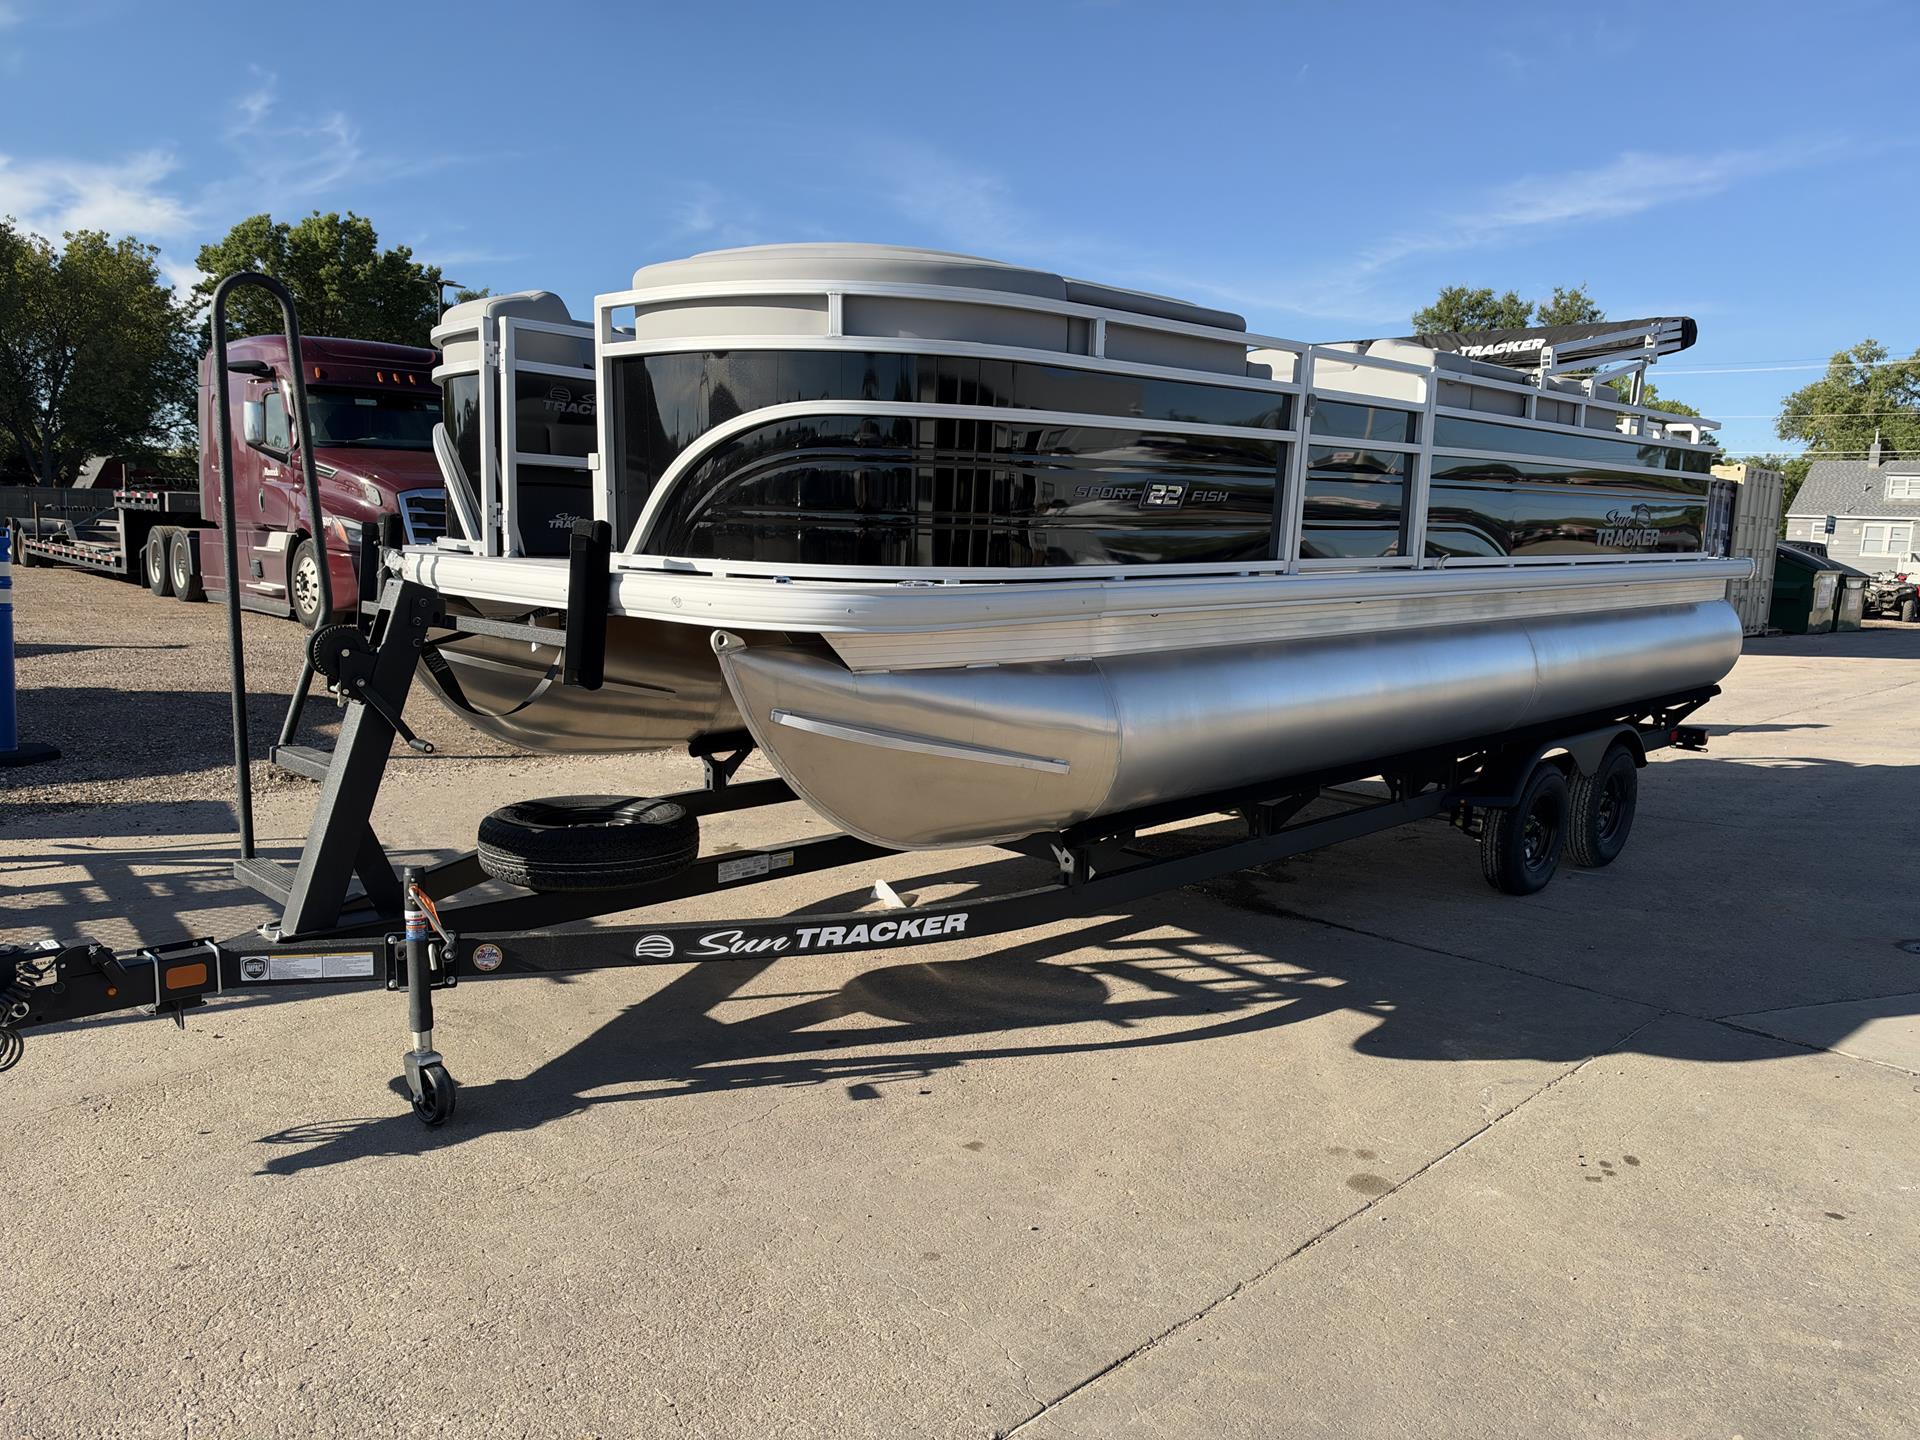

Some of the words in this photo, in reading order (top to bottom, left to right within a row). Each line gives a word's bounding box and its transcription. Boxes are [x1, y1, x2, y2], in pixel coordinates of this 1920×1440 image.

[1459, 338, 1546, 357] TRACKER
[543, 399, 597, 416] TRAC
[1074, 485, 1137, 499] SPORT
[1147, 484, 1183, 505] 22
[1191, 490, 1230, 502] FISH
[1602, 508, 1633, 528] Sun
[1595, 527, 1661, 547] TRACKER
[686, 930, 791, 956] Sun
[796, 912, 969, 949] TRACKER
